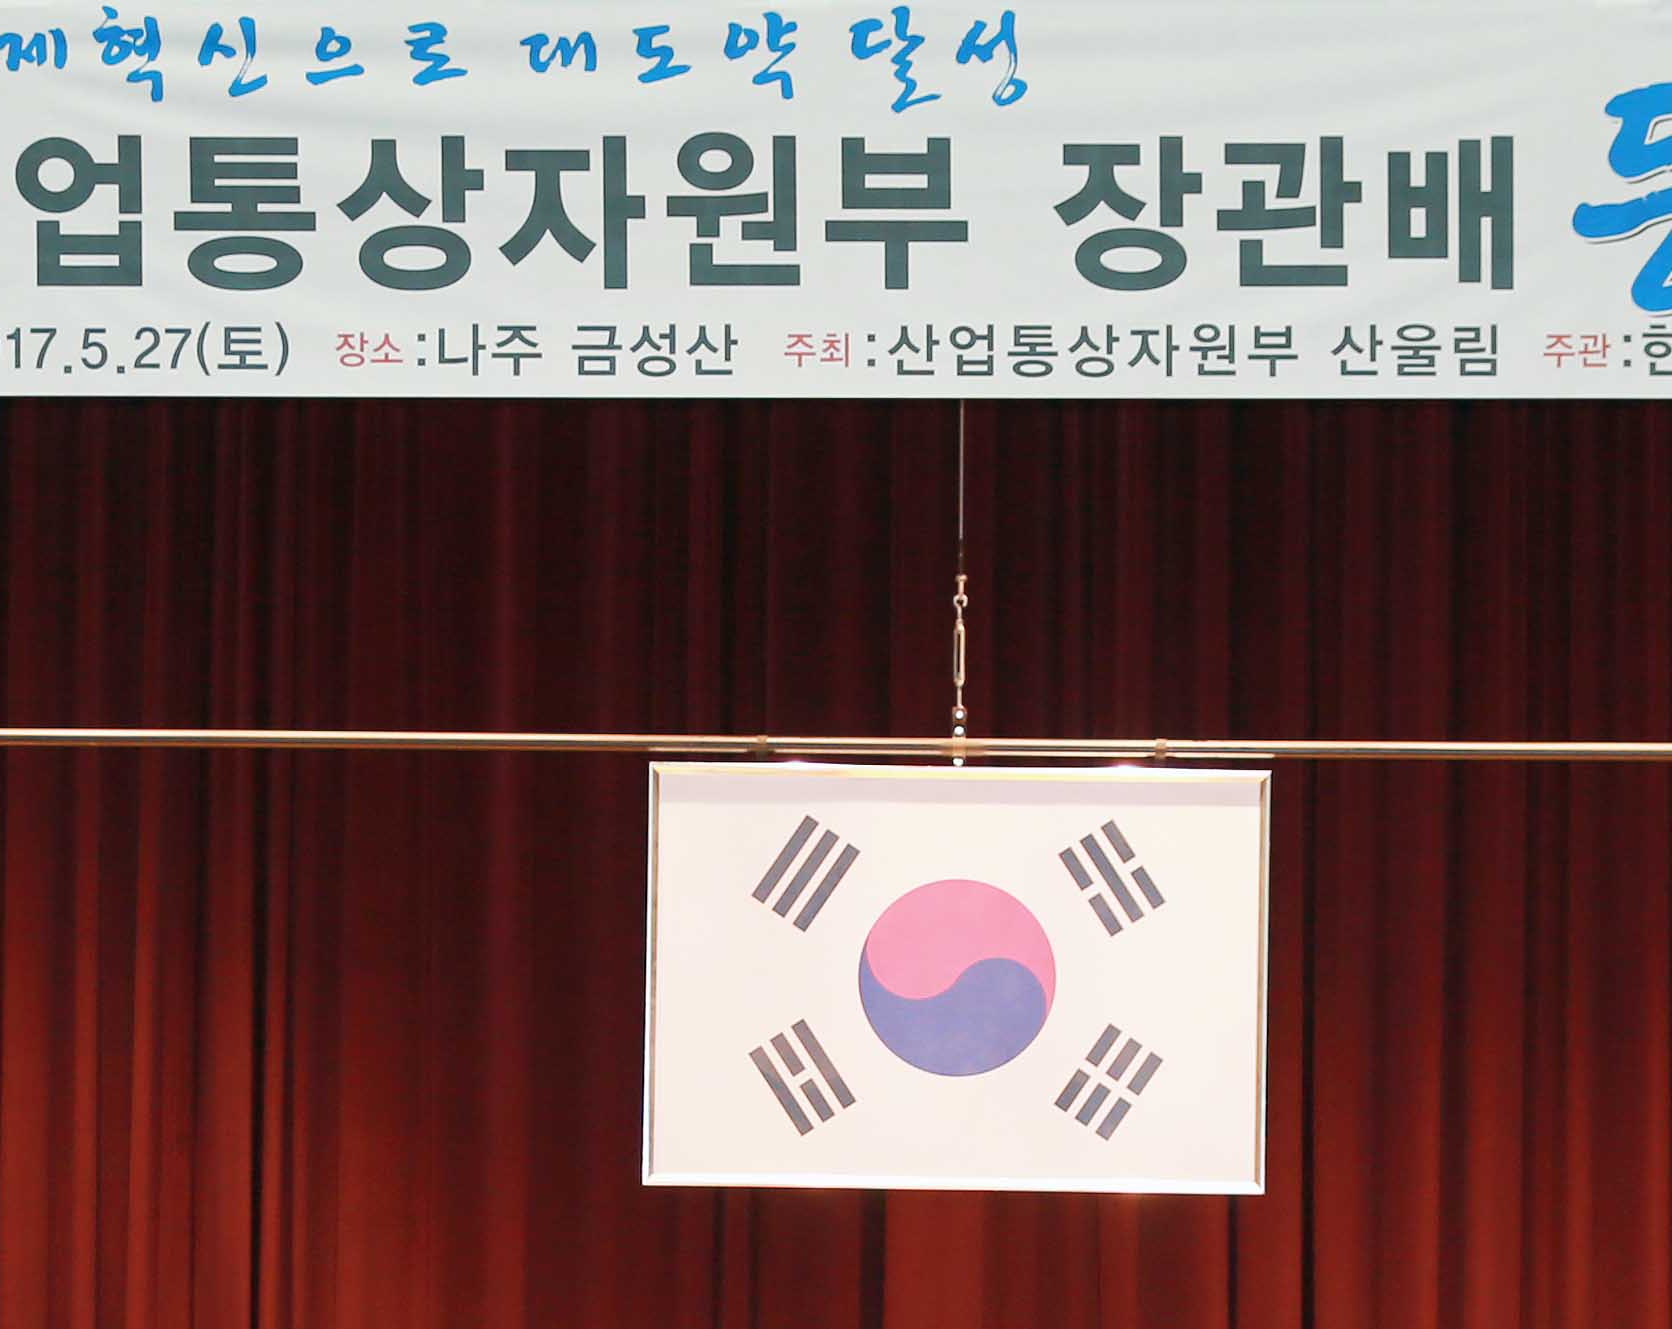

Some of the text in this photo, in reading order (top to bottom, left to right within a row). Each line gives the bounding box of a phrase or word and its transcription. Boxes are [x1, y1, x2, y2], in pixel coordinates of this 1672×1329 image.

[520, 11, 800, 102] 대도약
[848, 5, 1030, 113] 달성
[1053, 135, 1516, 294] 장관배
[572, 324, 740, 378] 금성산
[1332, 325, 1498, 378] 산울림
